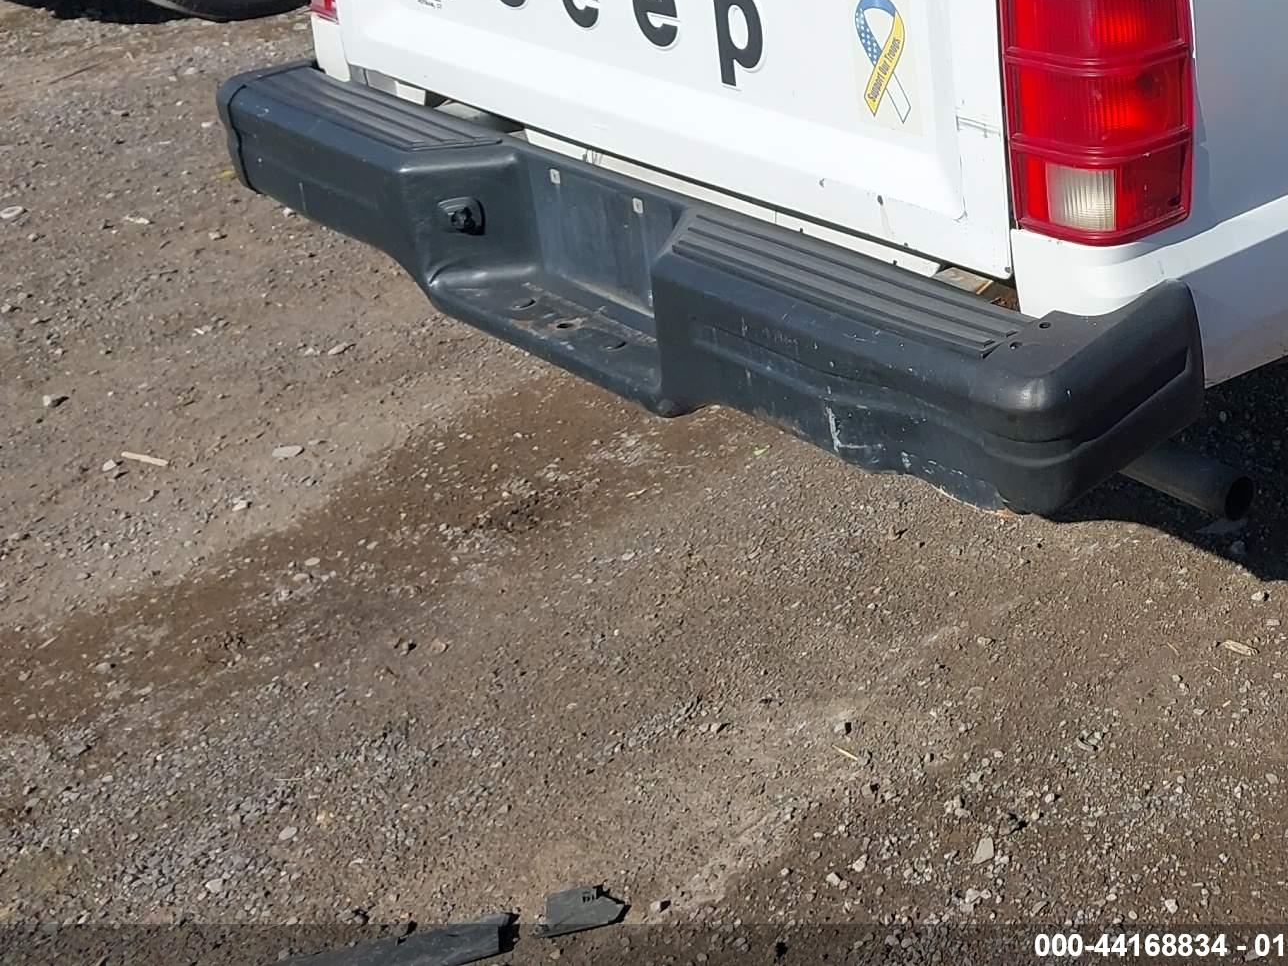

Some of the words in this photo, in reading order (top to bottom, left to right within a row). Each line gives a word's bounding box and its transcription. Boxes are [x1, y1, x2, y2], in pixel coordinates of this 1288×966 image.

[868, 73, 885, 100] Support
[879, 62, 890, 75] Our
[885, 38, 900, 61] Troops
